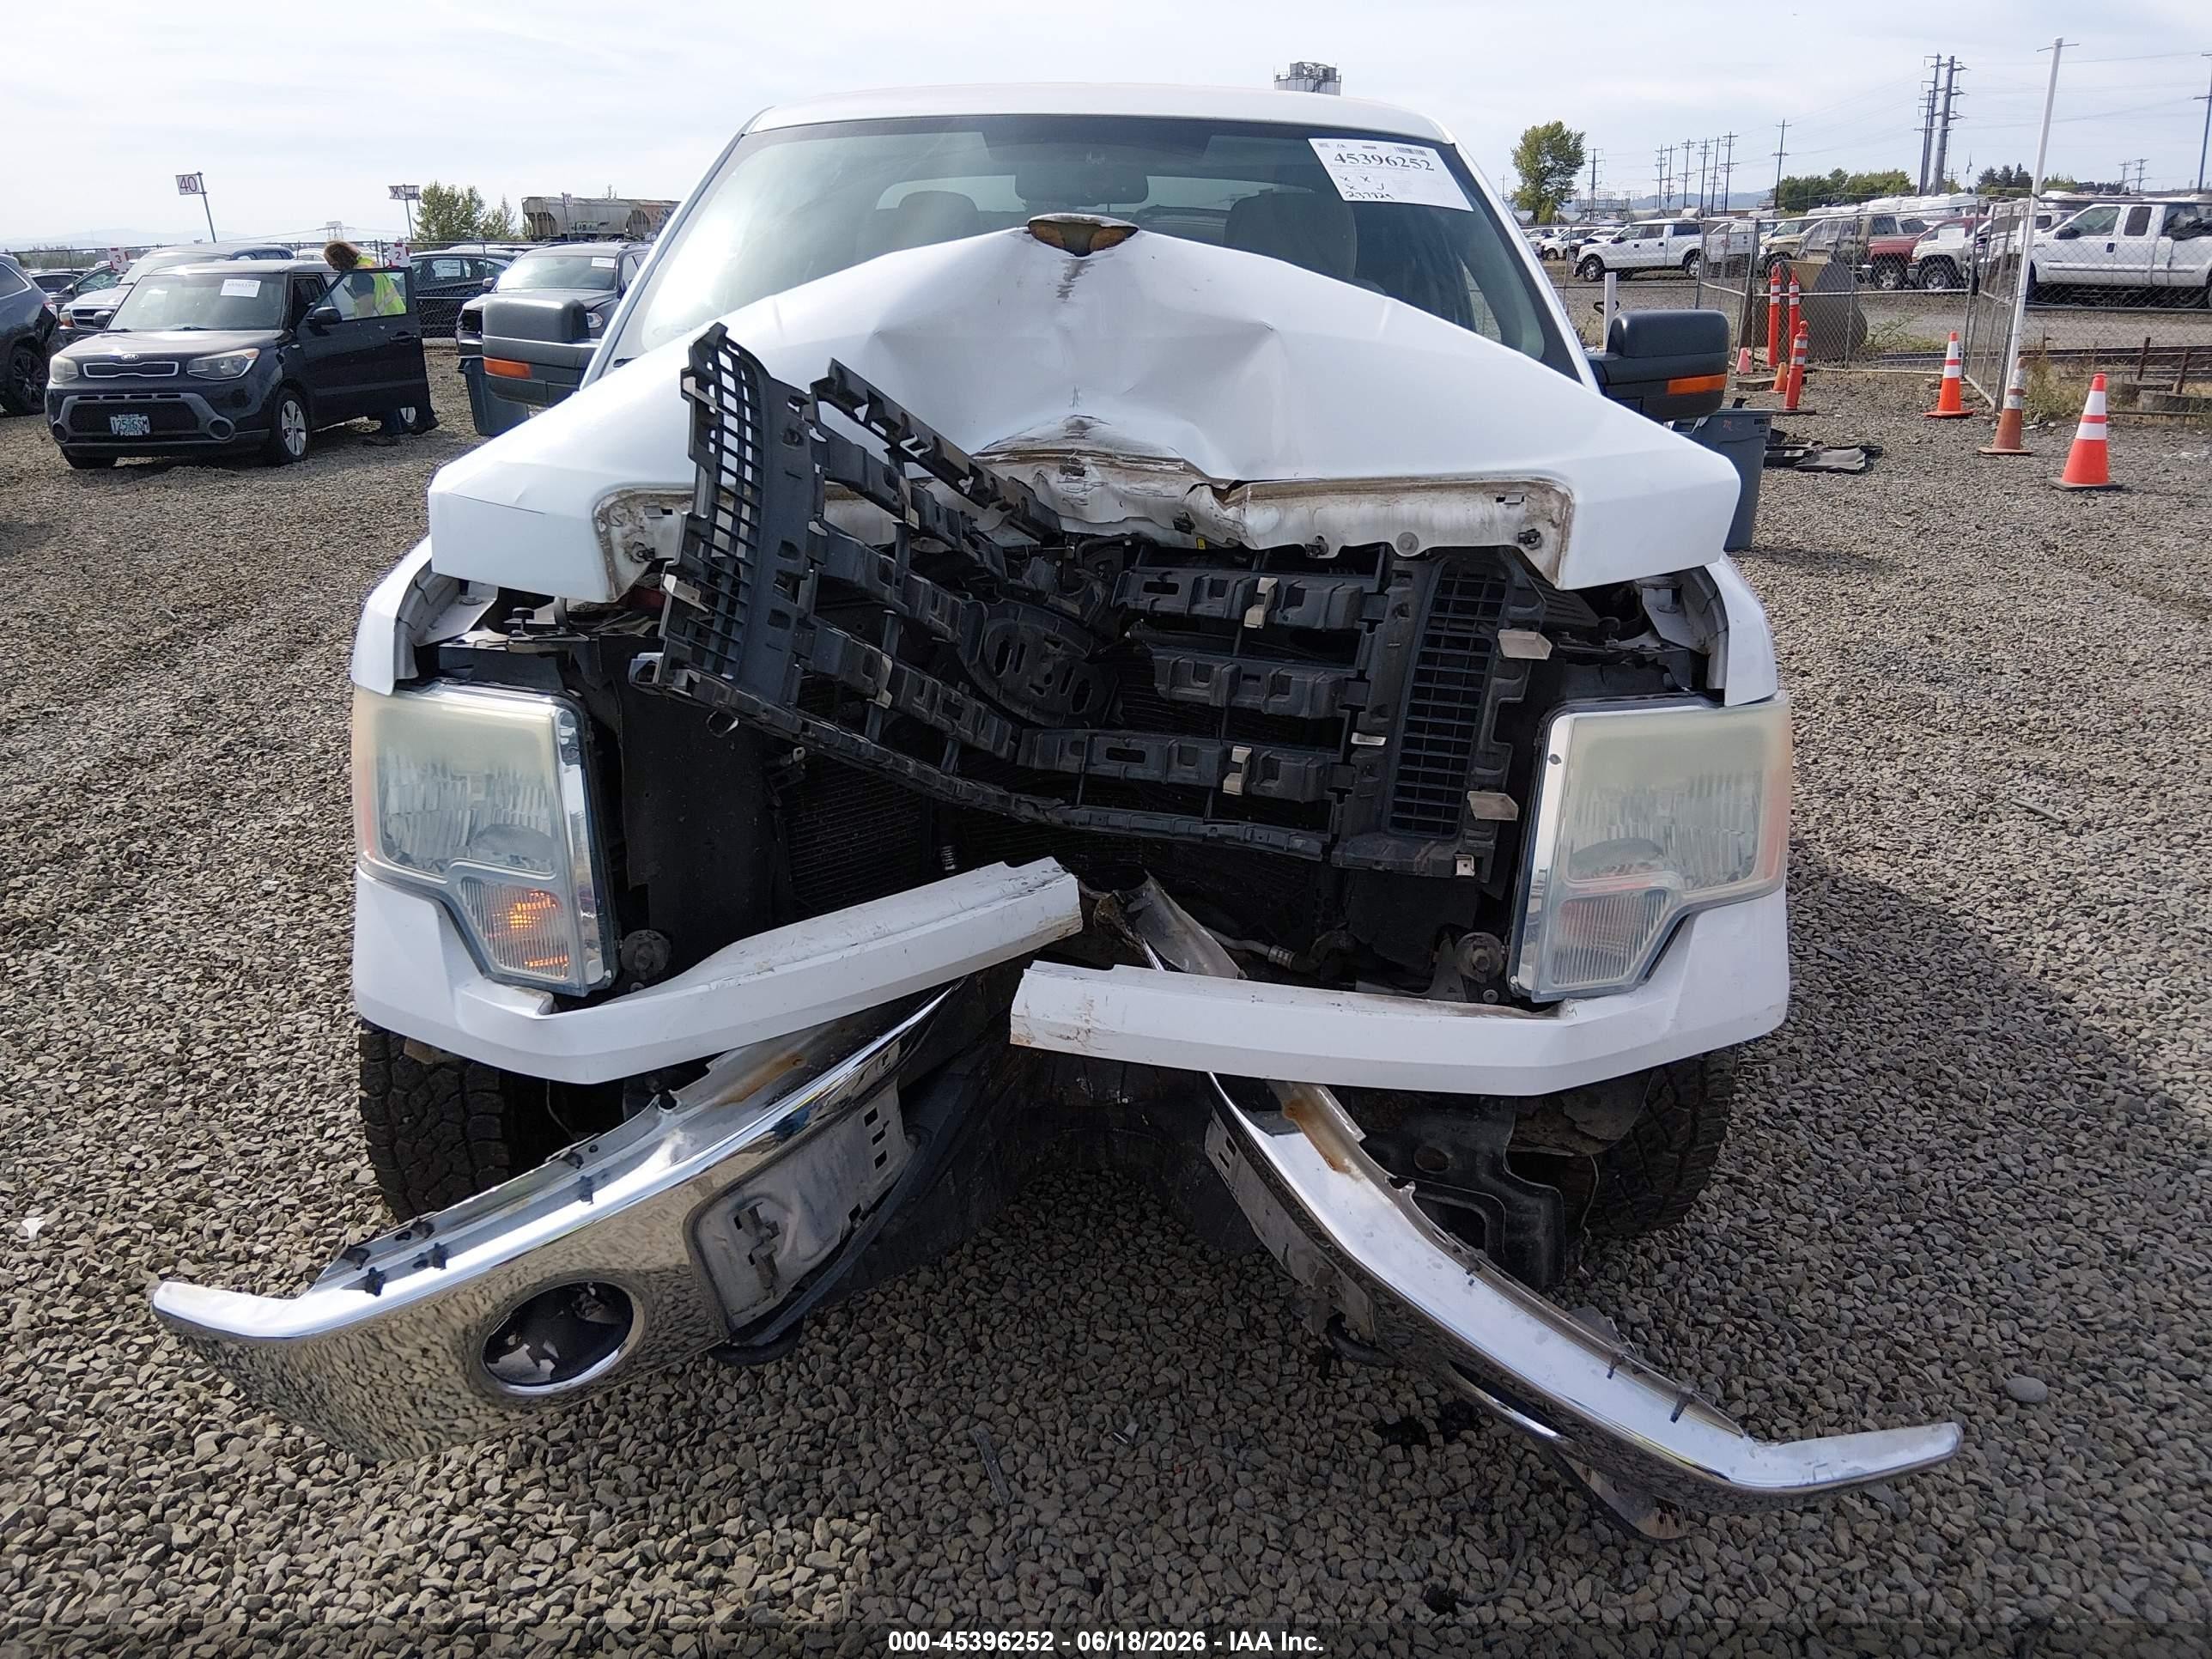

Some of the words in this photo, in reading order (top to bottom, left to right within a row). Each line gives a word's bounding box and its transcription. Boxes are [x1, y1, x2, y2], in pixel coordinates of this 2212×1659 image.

[1334, 153, 1435, 172] 45396252
[180, 176, 198, 192] 40
[114, 254, 123, 264] 3
[395, 251, 402, 260] 2
